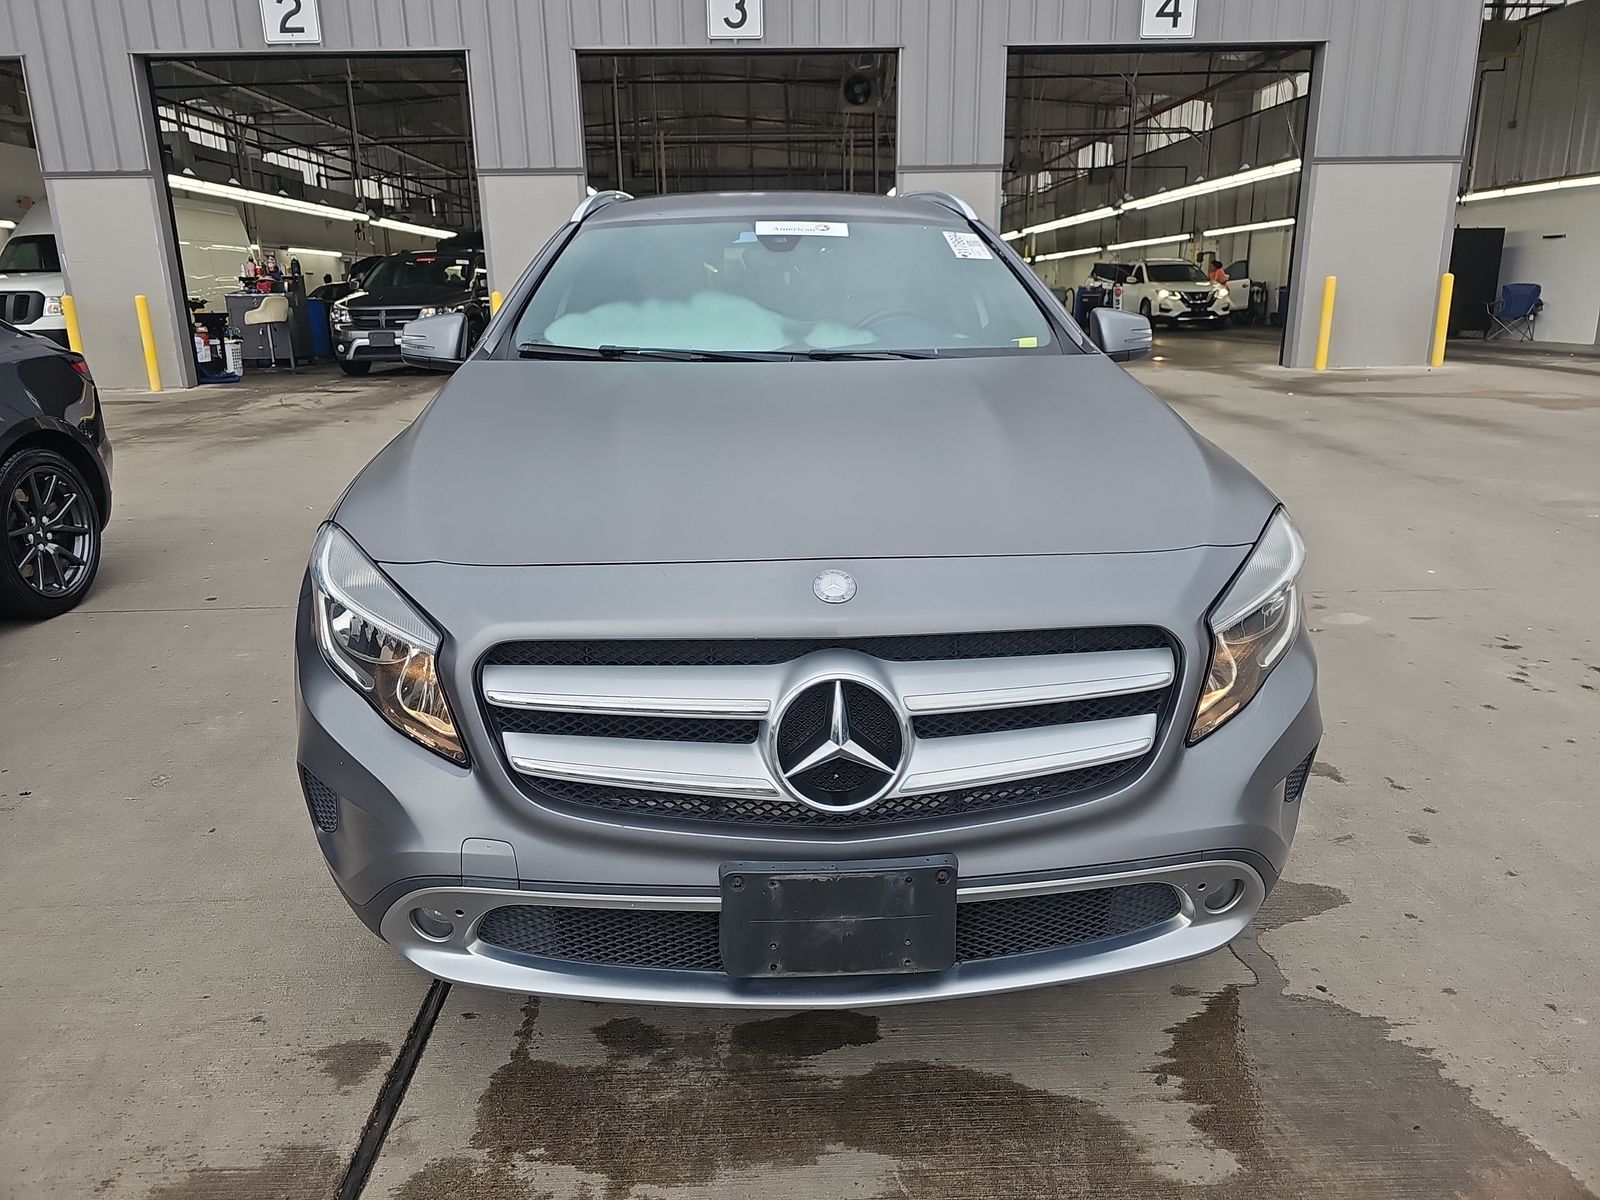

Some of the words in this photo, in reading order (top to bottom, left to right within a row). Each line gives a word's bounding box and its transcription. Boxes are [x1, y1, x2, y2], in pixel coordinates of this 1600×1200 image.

[276, 0, 305, 33] 2
[723, 0, 747, 29] 3
[1155, 0, 1182, 28] 4
